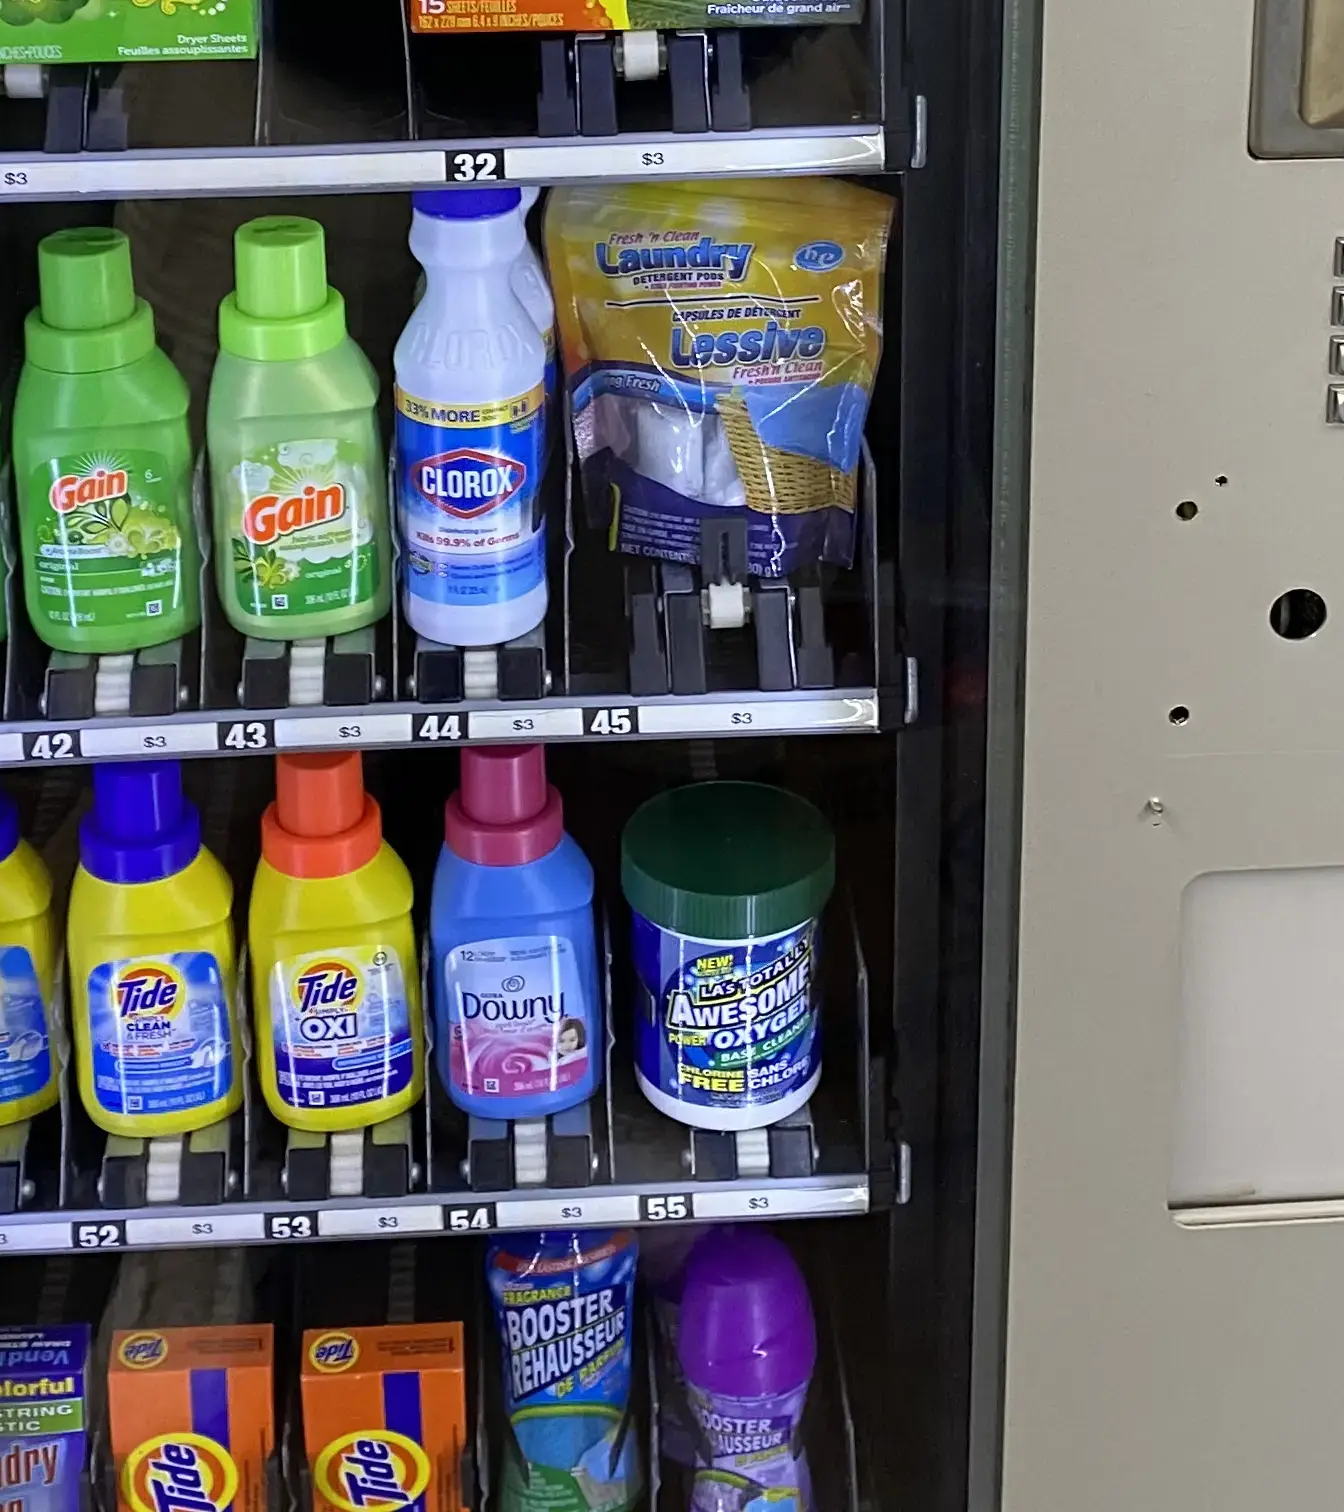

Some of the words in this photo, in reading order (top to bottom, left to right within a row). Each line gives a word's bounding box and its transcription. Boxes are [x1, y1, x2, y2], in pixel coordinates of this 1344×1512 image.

[708, 3, 765, 14] Fraîcheur
[787, 3, 822, 15] grand
[118, 46, 160, 55] Feuilles
[177, 34, 208, 45] Dryer
[210, 34, 247, 43] Sheets
[453, 153, 497, 181] 32
[641, 152, 665, 166] $3
[4, 172, 28, 186] $3
[609, 233, 642, 245] Fresh
[663, 231, 700, 242] Clean
[596, 237, 753, 282] Laundry
[634, 272, 693, 285] DETERGENT
[697, 272, 724, 281] PODS
[672, 308, 724, 322] CAPSULES
[728, 307, 740, 319] DE
[672, 322, 824, 367] Lessive
[784, 361, 823, 374] Clean
[625, 374, 660, 392] Fresh
[431, 408, 480, 423] MORE
[50, 470, 128, 513] Gain
[422, 465, 514, 498] CLOROX
[243, 484, 344, 544] Gain
[473, 538, 485, 547] of
[621, 543, 640, 555] NET
[419, 715, 461, 740] 44
[512, 718, 534, 731] $3
[590, 708, 632, 735] 45
[731, 712, 752, 725] $3
[31, 733, 74, 759] 42
[143, 735, 167, 748] $3
[224, 722, 268, 749] 43
[339, 725, 361, 738] $3
[460, 950, 475, 962] 12
[696, 954, 734, 970] NEW!
[741, 938, 809, 994] TOTALLY
[118, 977, 178, 1018] Tide
[298, 972, 358, 1013] Tide
[671, 961, 810, 1027] AWESOME
[462, 991, 568, 1024] Downy
[126, 1021, 171, 1032] CLEAN
[301, 1013, 358, 1042] OXI
[668, 1033, 707, 1046] POWER
[721, 1049, 757, 1062] BASE
[679, 1064, 745, 1079] CHLORINE
[748, 1059, 789, 1077] SANS
[680, 1077, 746, 1093] FREE
[449, 1208, 490, 1231] 54
[561, 1206, 582, 1218] $3
[647, 1196, 687, 1220] 55
[748, 1196, 769, 1209] $3
[79, 1224, 120, 1248] 52
[192, 1223, 213, 1235] $3
[271, 1215, 311, 1239] 53
[377, 1216, 398, 1228] $3
[506, 1289, 613, 1351] BOOSTER
[123, 1338, 165, 1362] Tide
[314, 1338, 355, 1363] Tide
[512, 1311, 625, 1399] REHAUSSEUR
[339, 1438, 414, 1510] Tide
